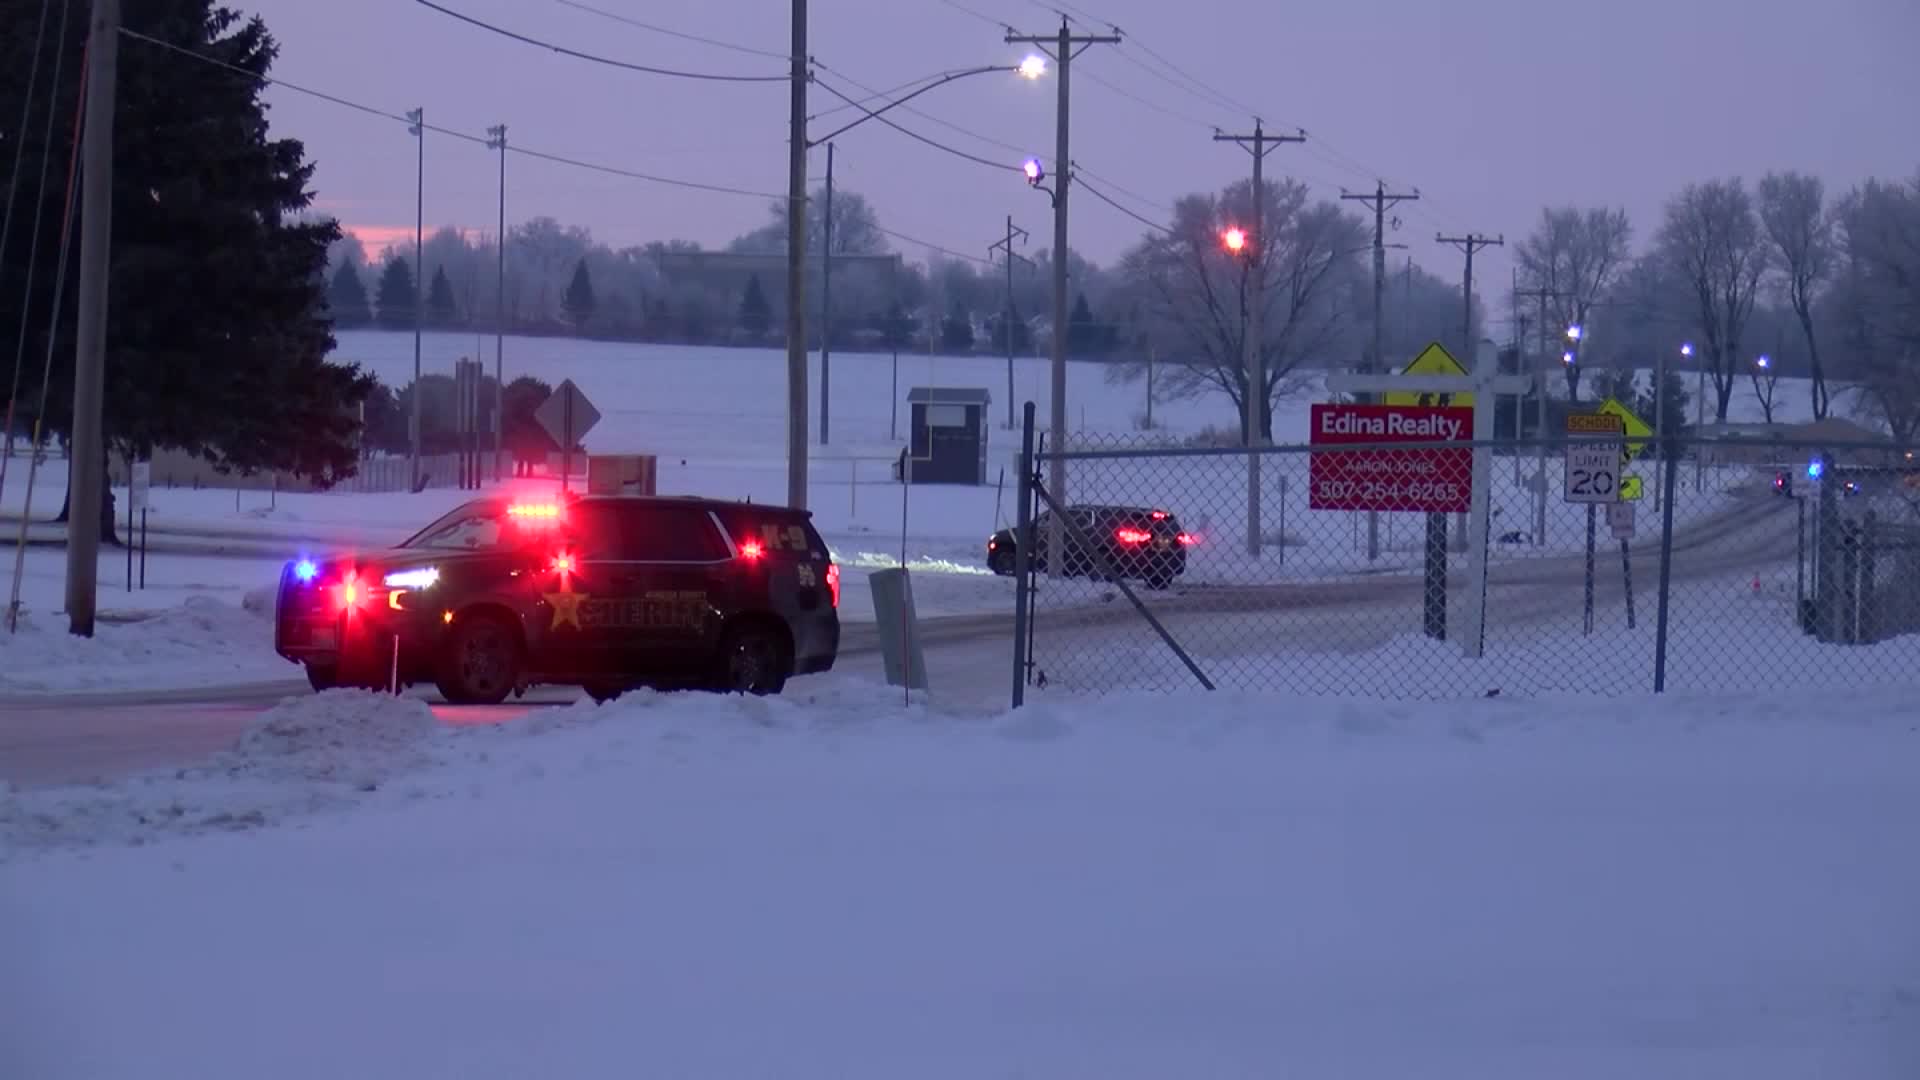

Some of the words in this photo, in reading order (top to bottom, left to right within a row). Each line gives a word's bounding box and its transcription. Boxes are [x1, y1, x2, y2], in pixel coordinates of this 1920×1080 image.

[1322, 412, 1385, 435] Edina
[1569, 416, 1618, 430] SCHOOL
[1345, 460, 1391, 474] AARON
[1395, 461, 1436, 474] JONES
[1575, 455, 1611, 467] LIMIT
[1320, 481, 1458, 501] 507-254-6265
[1571, 469, 1613, 496] 20
[761, 524, 808, 550] K-9
